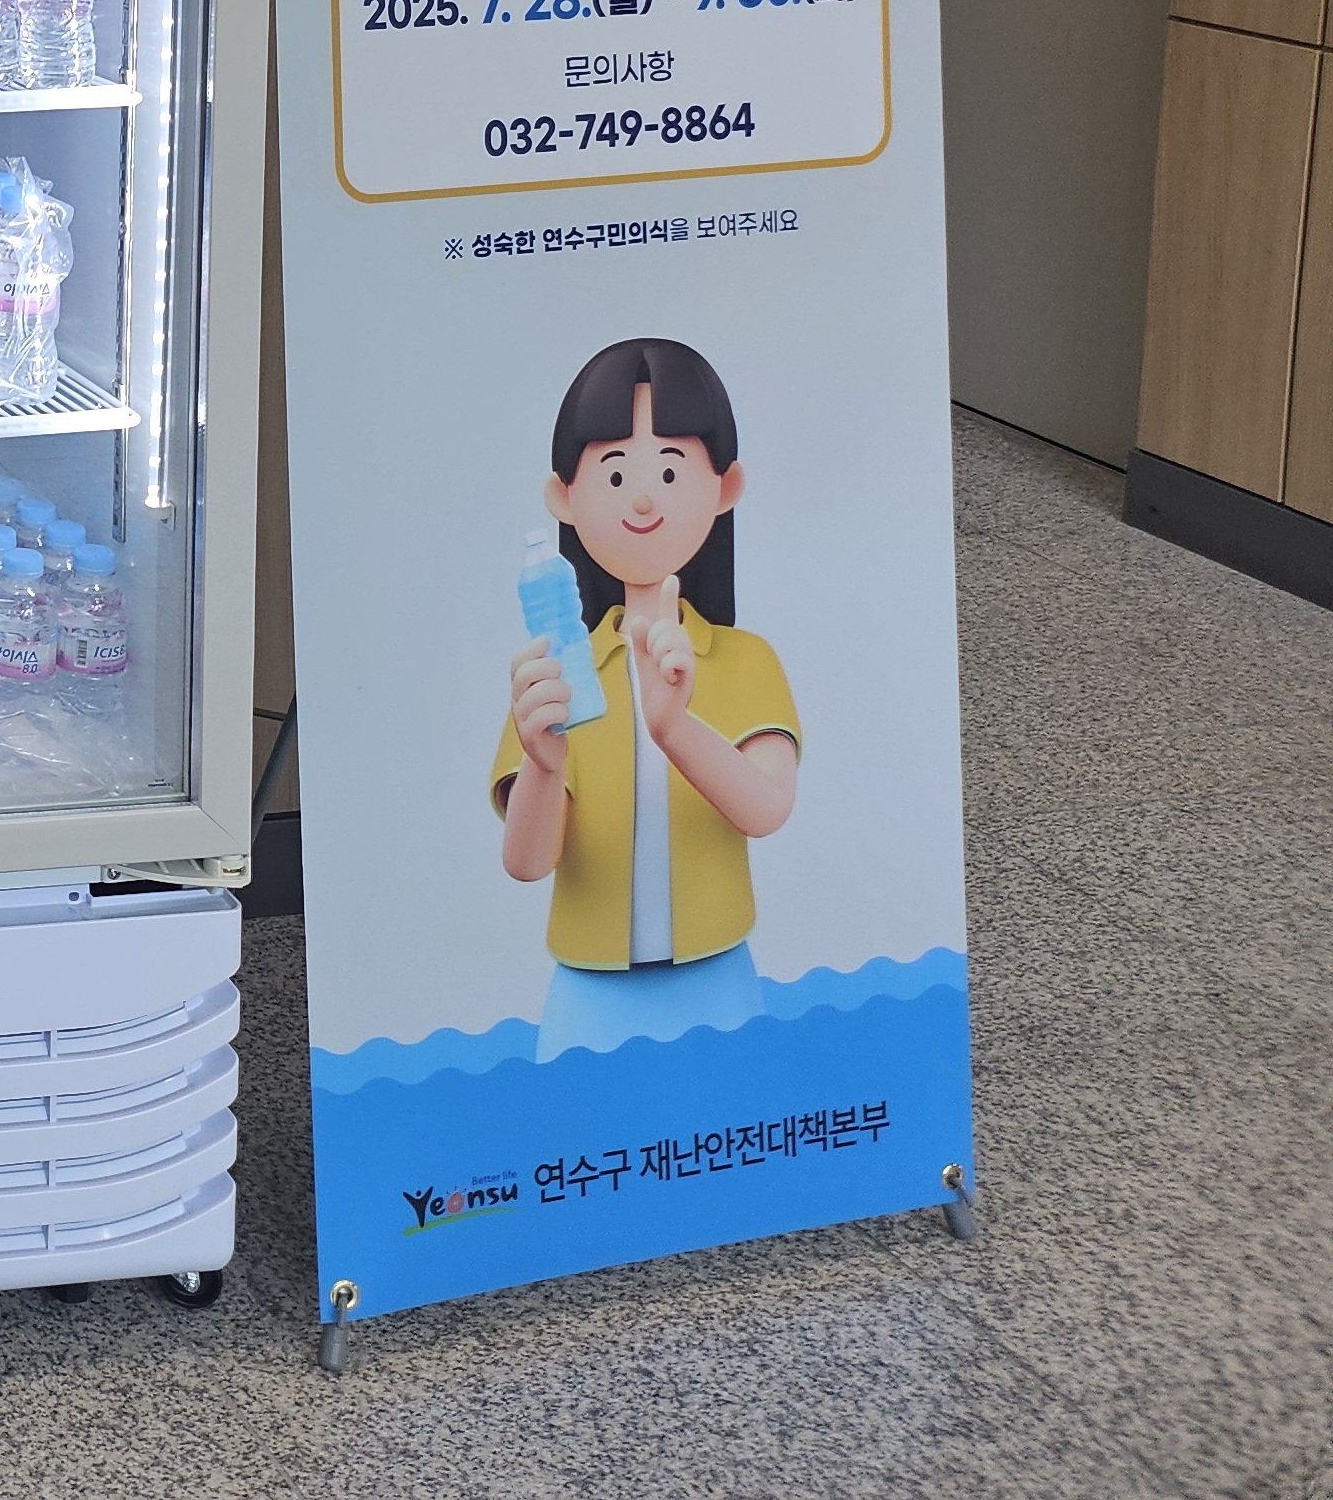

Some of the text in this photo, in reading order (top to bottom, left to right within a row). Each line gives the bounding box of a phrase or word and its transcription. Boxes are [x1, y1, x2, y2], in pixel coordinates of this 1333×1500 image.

[564, 50, 675, 89] 문의사항
[484, 102, 755, 157] 032-749-8864
[471, 230, 535, 259] 성숙한
[542, 216, 690, 253] 연수구민의식을
[696, 209, 799, 240] 보여주세요
[534, 1100, 890, 1204] 연수구 재난안전대책본부
[472, 1170, 517, 1186] Better life
[403, 1180, 518, 1228] Yeonsu
